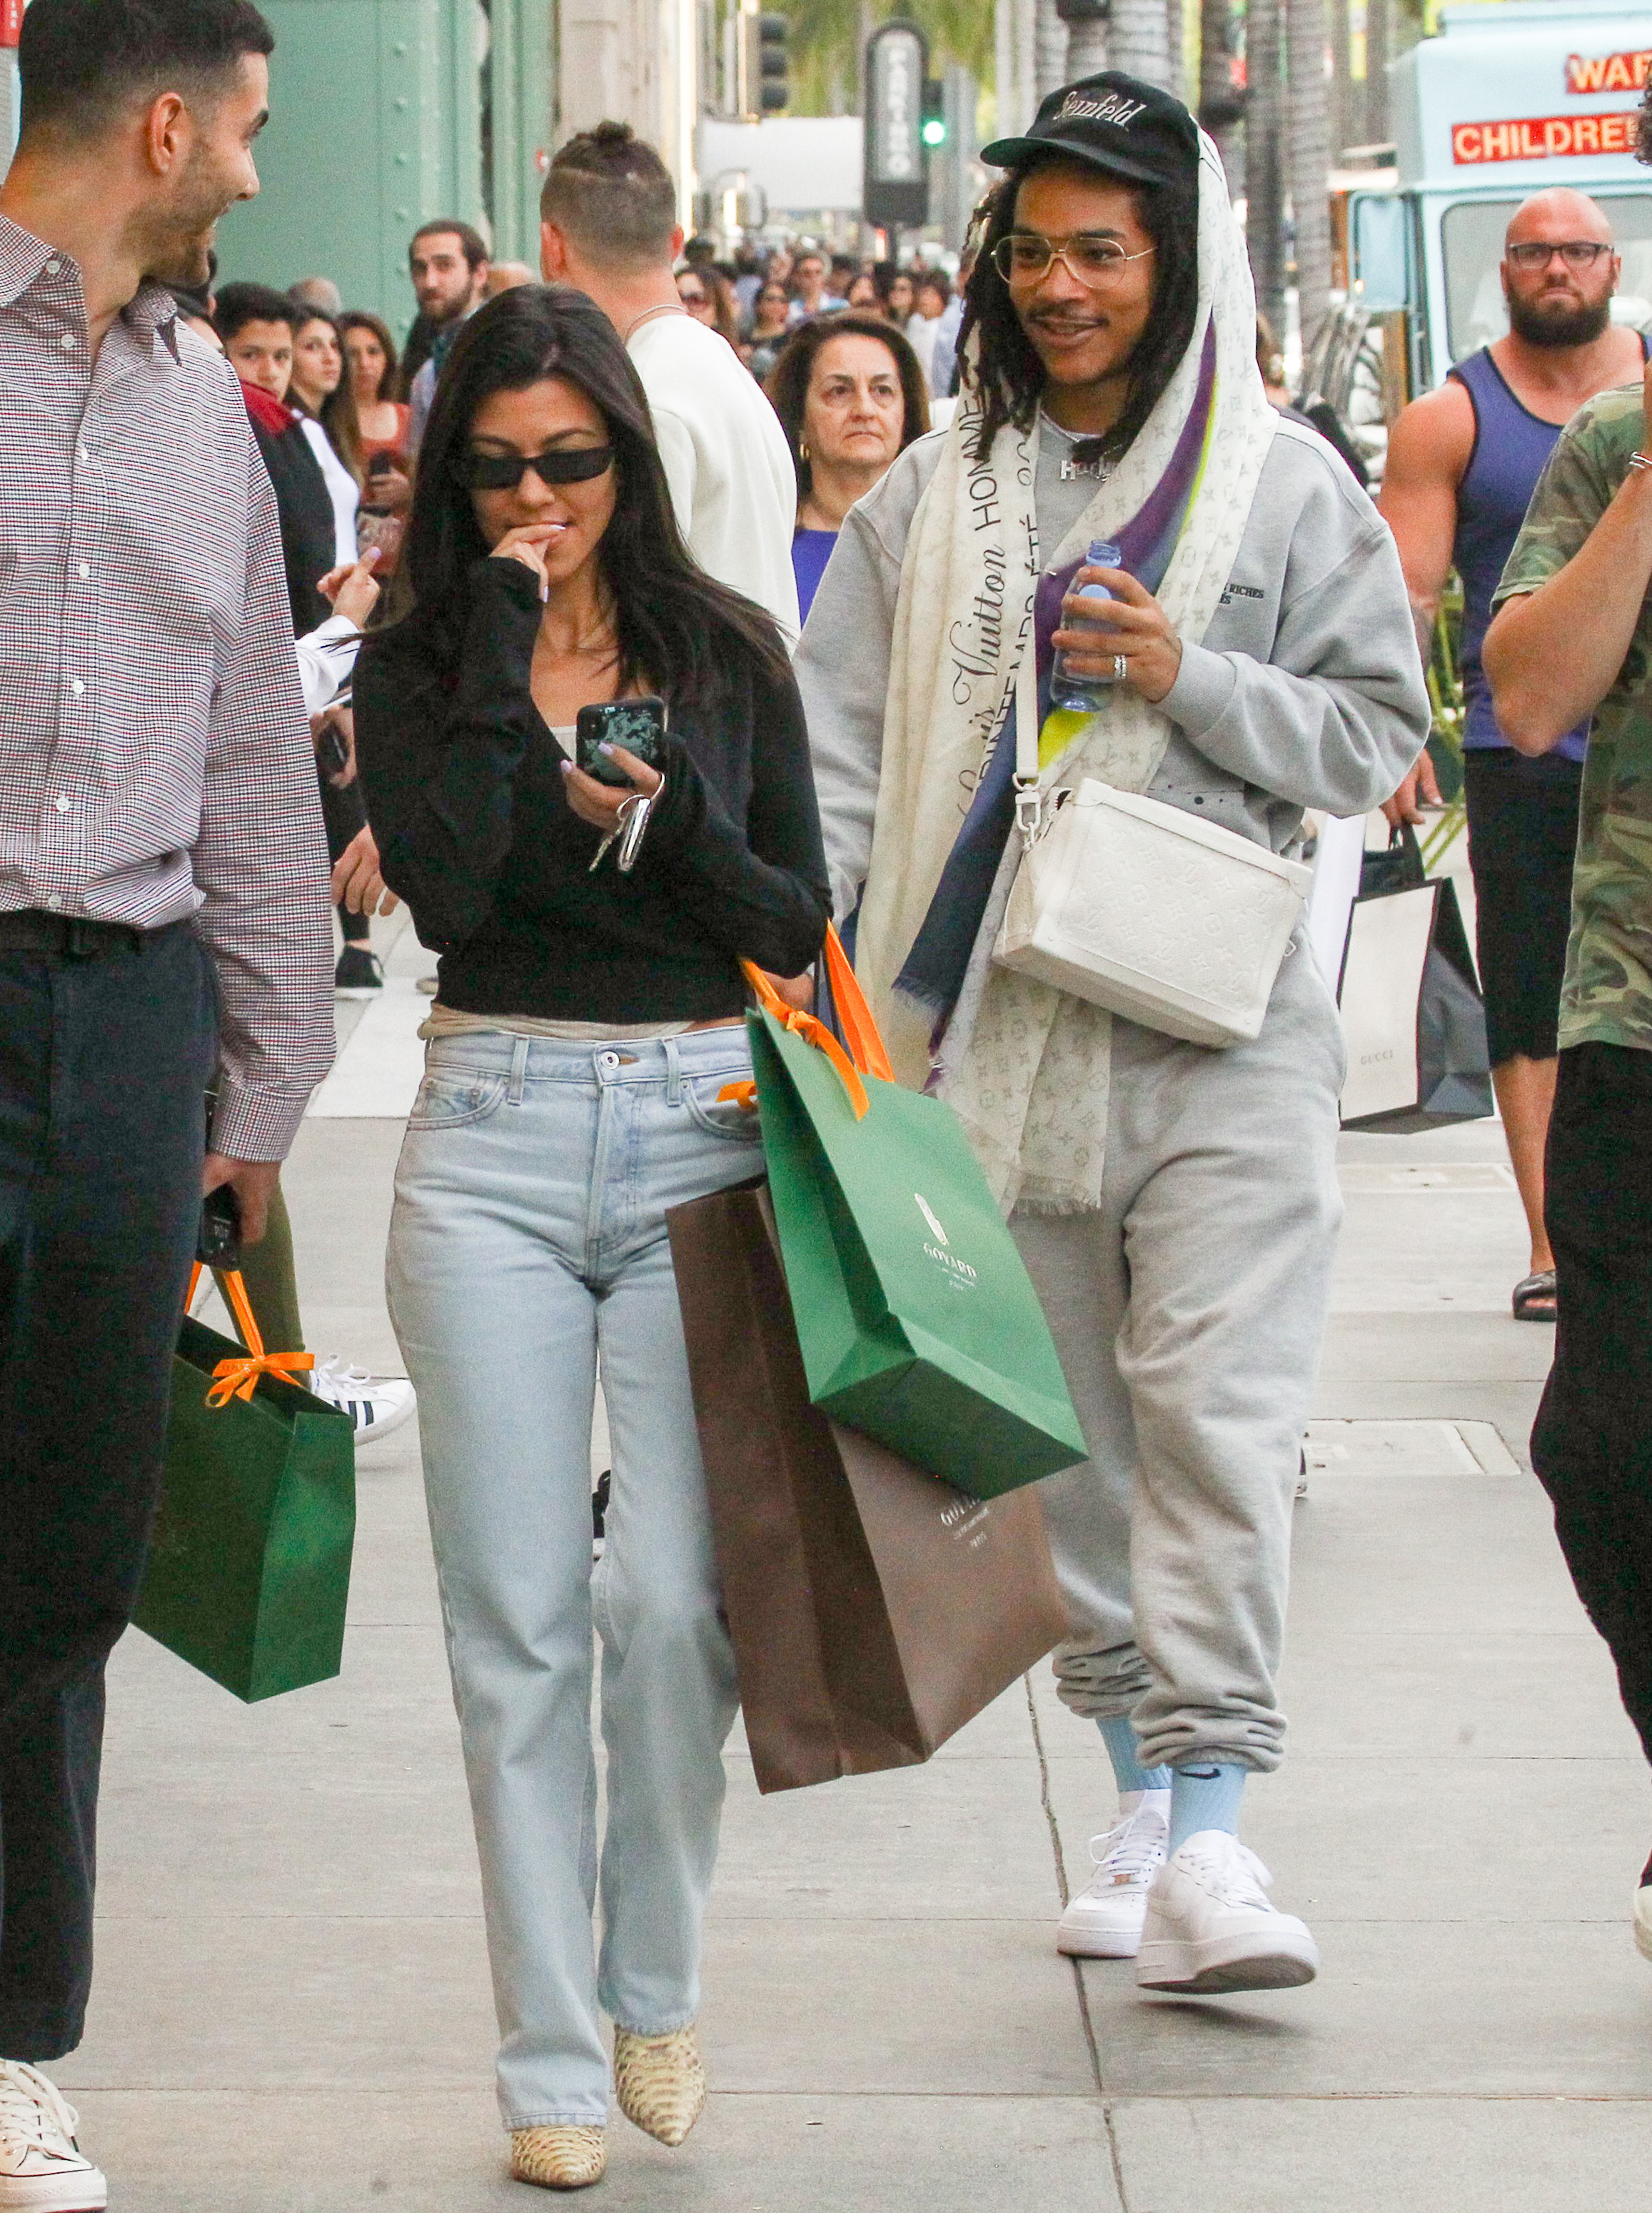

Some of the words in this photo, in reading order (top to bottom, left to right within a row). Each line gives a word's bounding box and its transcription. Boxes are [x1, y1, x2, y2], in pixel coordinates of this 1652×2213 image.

[1052, 91, 1147, 126] Seinfeld
[1229, 583, 1264, 598] RICHES
[949, 544, 1007, 705] Vuitton
